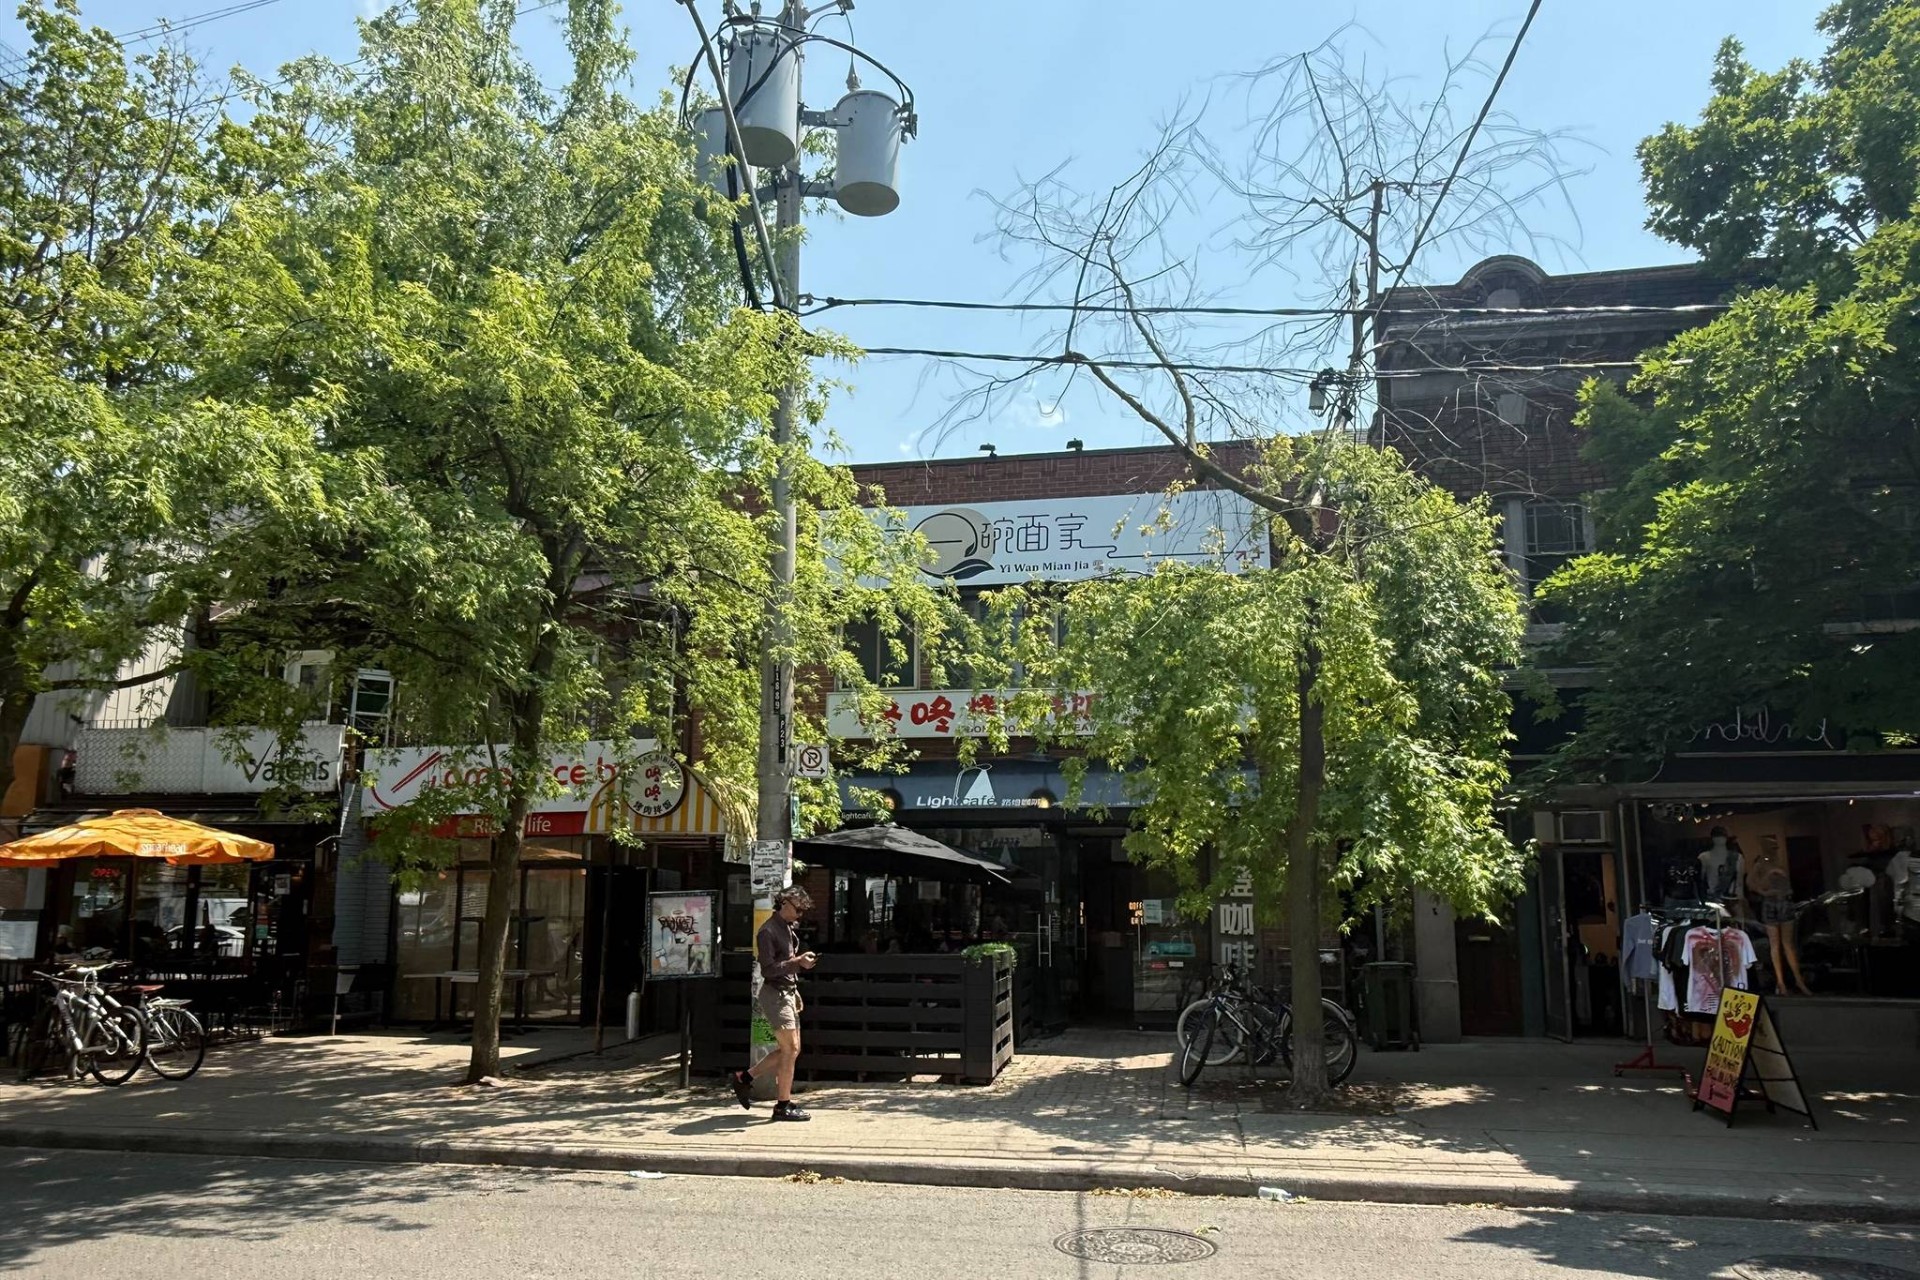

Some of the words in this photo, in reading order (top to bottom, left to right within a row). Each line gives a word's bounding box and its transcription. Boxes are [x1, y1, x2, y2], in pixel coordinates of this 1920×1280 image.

[1000, 563, 1011, 573] Yi
[1014, 562, 1039, 573] Wan
[1042, 561, 1071, 571] Mian
[1074, 560, 1089, 571] Jia
[527, 815, 552, 833] life
